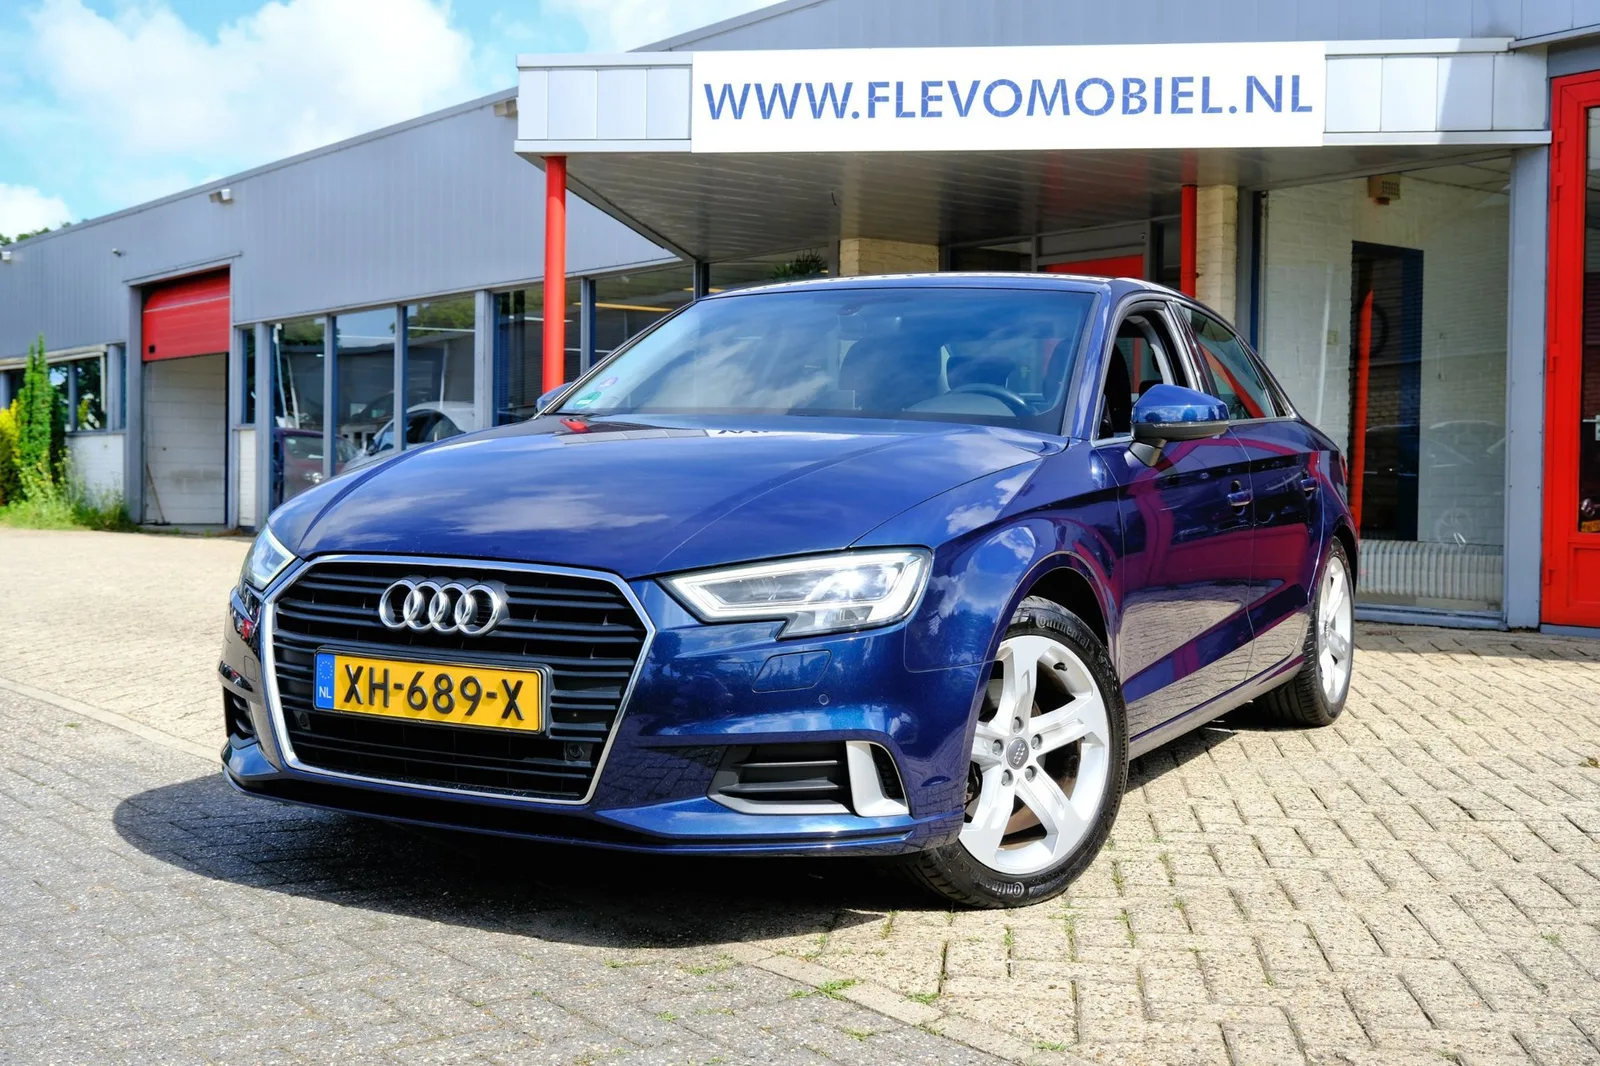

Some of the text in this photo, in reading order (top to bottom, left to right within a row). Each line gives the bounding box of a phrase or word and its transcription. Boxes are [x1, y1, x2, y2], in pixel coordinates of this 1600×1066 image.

[703, 75, 1313, 120] WWW.FLEVOMOBIEL.NL
[318, 686, 332, 699] NL
[344, 664, 524, 720] XH-689-X
